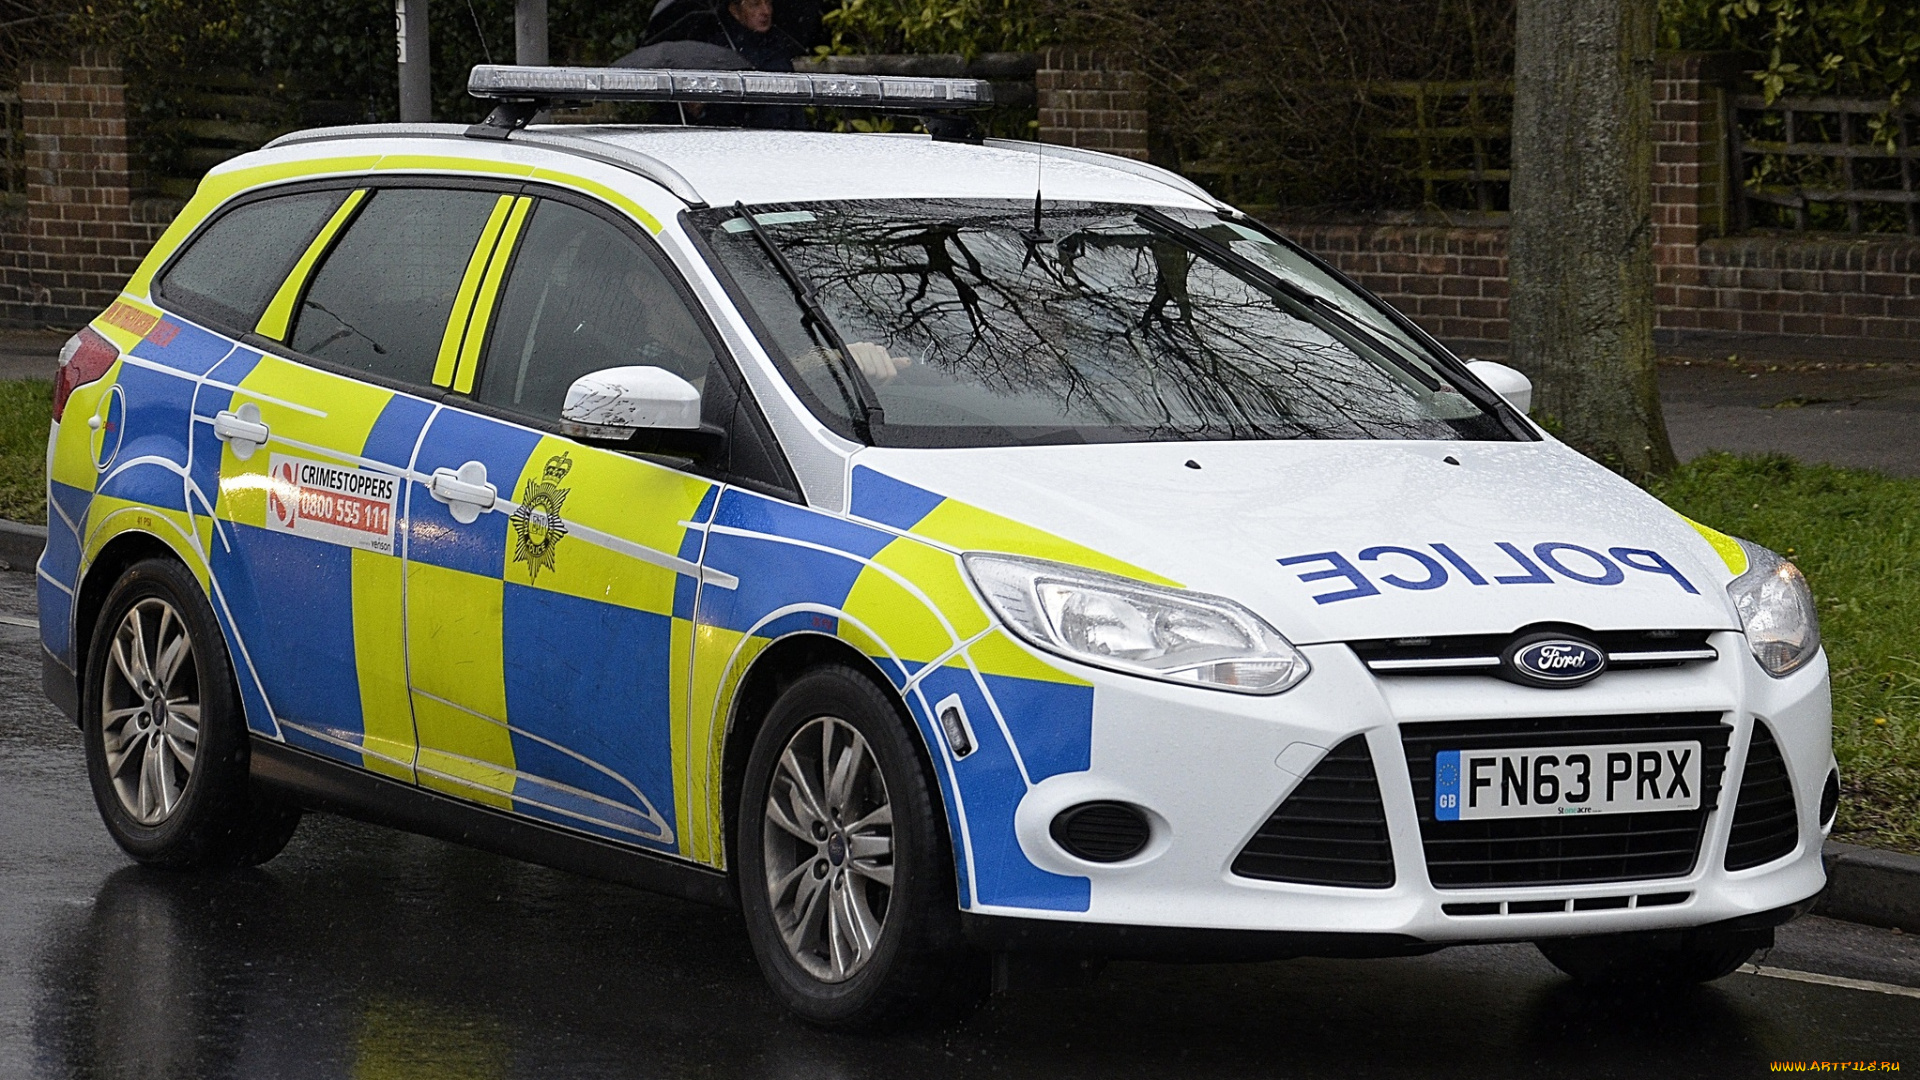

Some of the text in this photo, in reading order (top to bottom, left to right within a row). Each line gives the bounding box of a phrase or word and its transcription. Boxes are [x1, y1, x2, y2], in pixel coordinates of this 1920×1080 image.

[301, 464, 393, 500] CRIMESTOPPERS
[301, 492, 388, 531] 0800 555 111
[1537, 645, 1586, 669] Ford
[1468, 749, 1692, 808] FN63 PRX
[1439, 794, 1456, 808] GB
